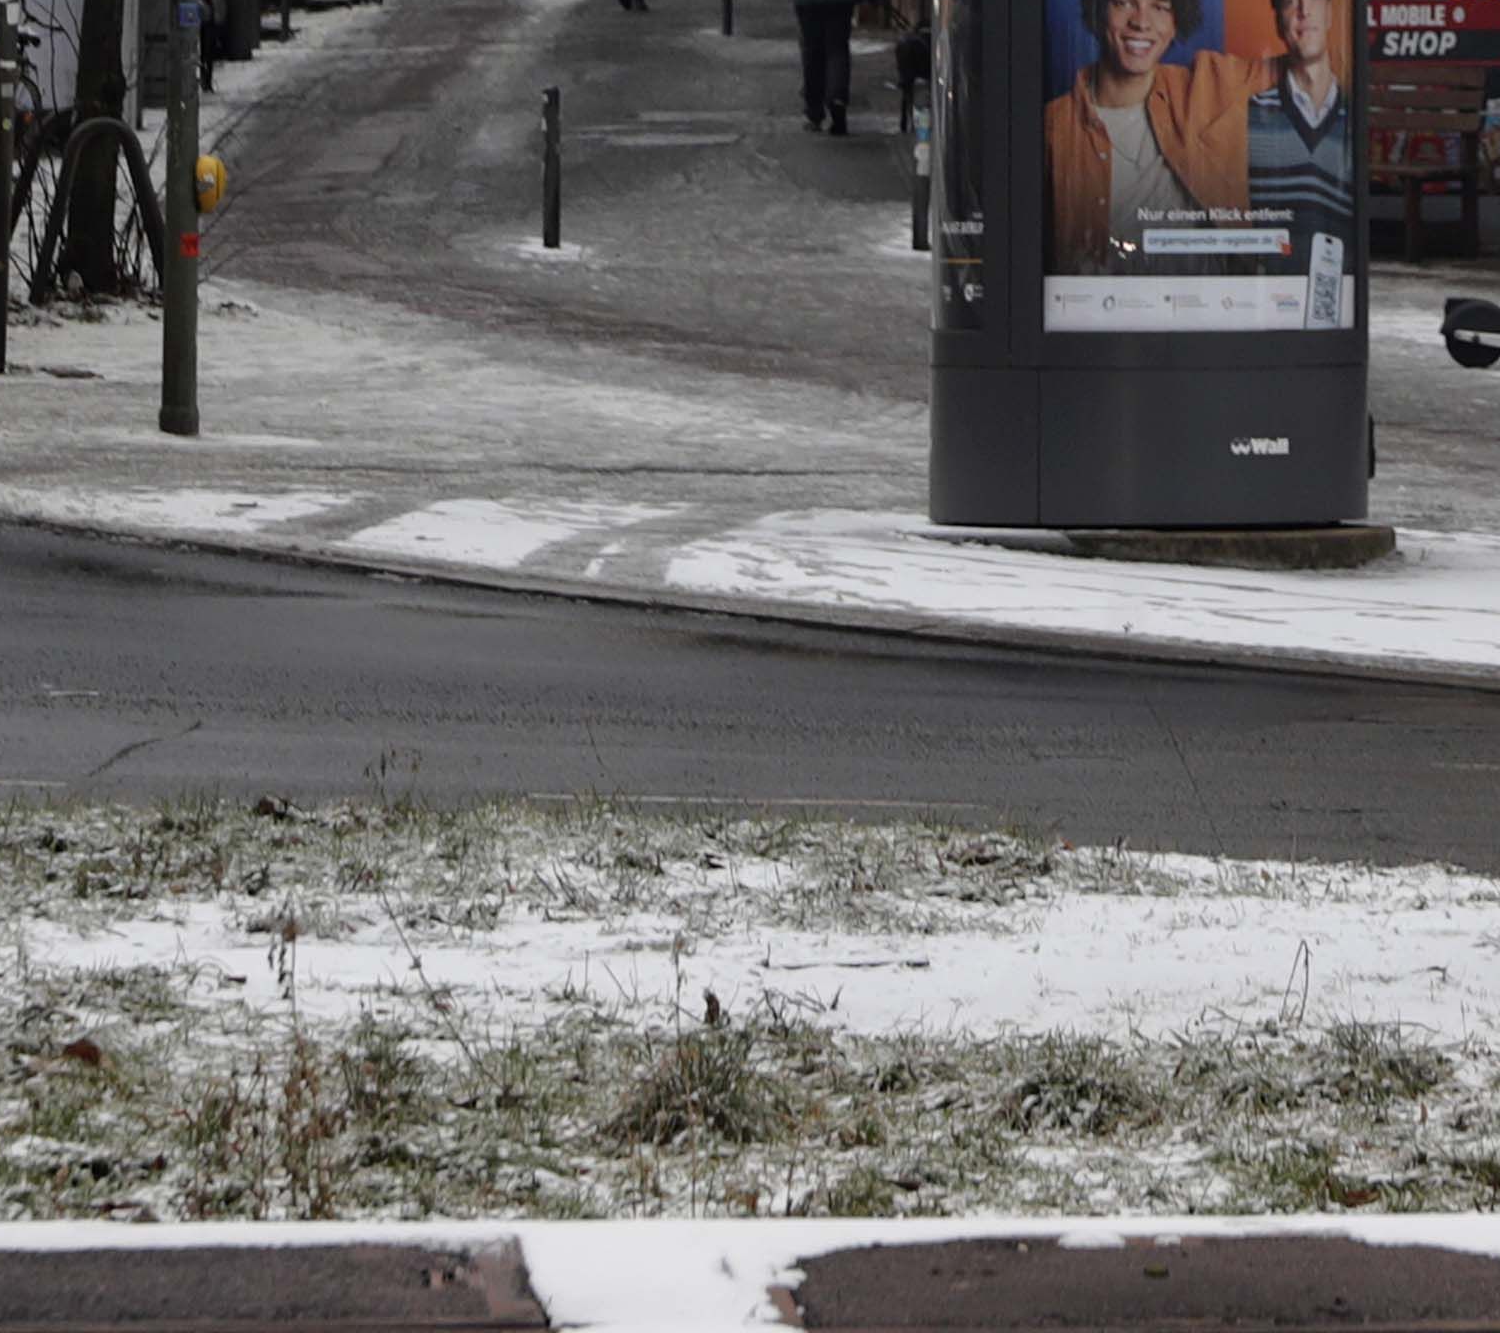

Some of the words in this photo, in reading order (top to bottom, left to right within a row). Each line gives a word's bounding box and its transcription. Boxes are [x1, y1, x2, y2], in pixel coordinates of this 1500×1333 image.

[1380, 4, 1447, 27] MOBILE
[1382, 30, 1458, 56] SHOP
[1136, 207, 1165, 222] Nur
[1167, 208, 1207, 222] einen
[1208, 207, 1242, 222] Klick
[1250, 436, 1290, 455] Wall
